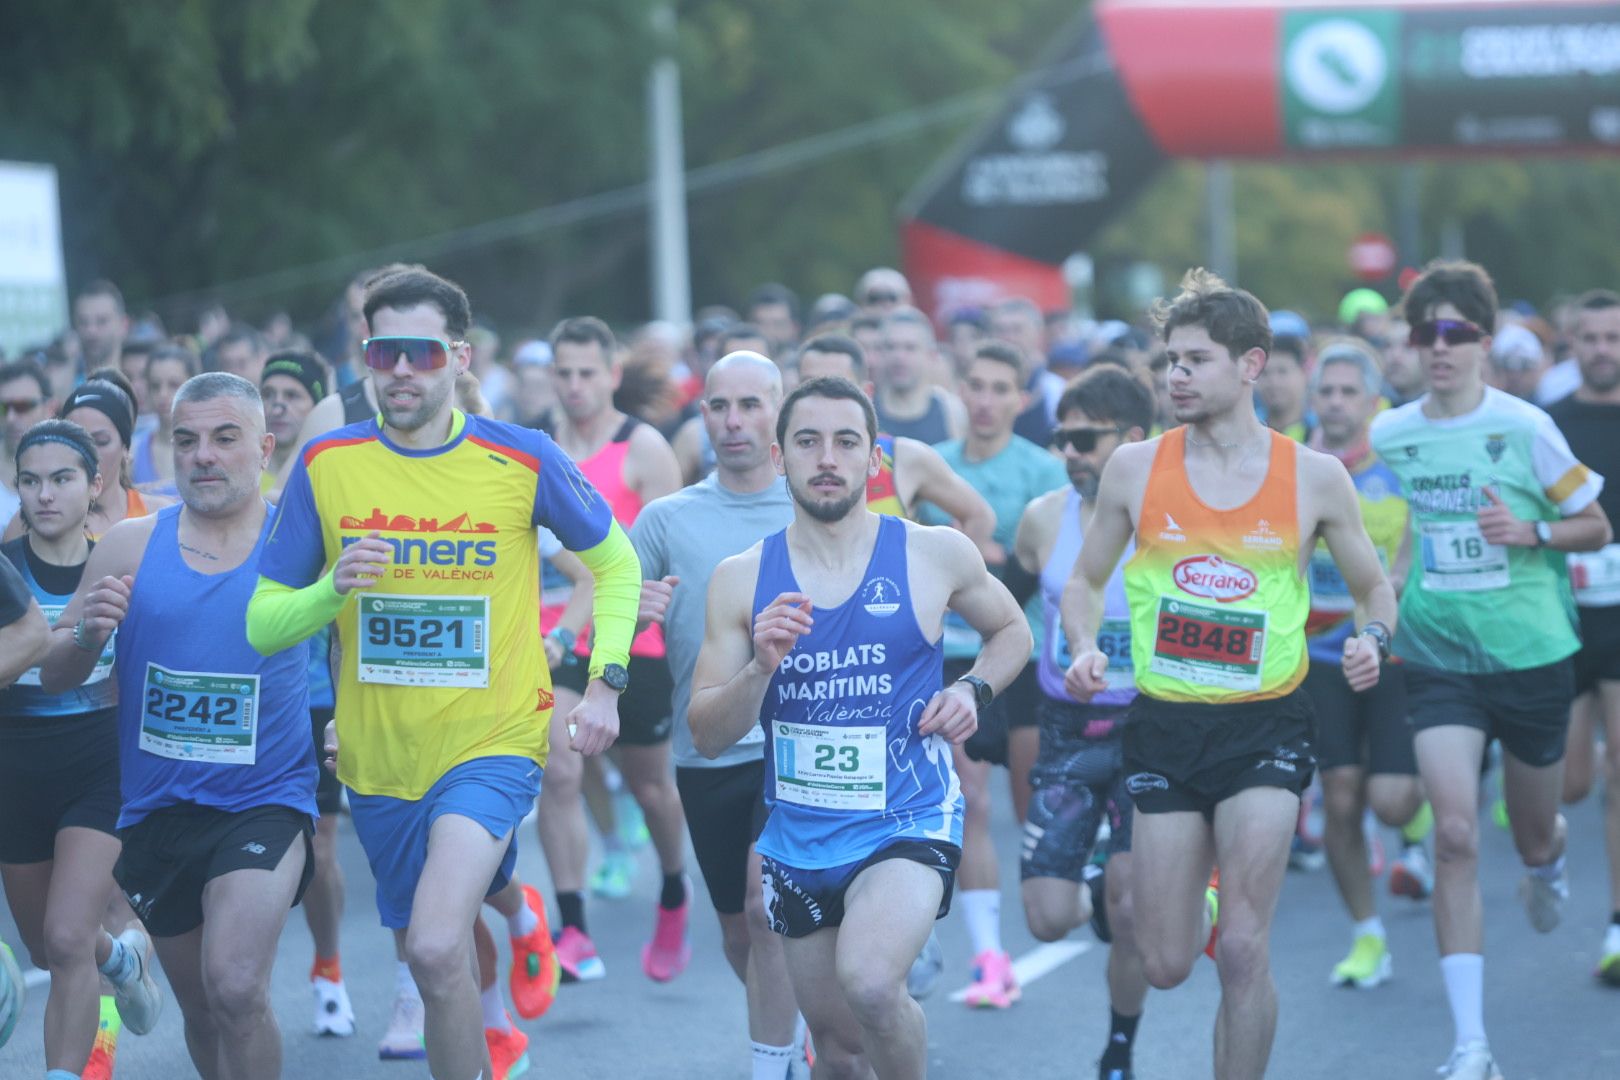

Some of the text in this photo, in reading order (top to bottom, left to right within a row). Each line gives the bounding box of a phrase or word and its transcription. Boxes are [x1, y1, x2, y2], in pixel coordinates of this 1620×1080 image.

[1450, 537, 1482, 559] 16
[394, 569, 415, 579] DE
[422, 567, 494, 580] VALÈNCIA
[1181, 565, 1251, 590] Serrano
[368, 616, 463, 648] 9521
[1160, 616, 1248, 656] 2848
[780, 643, 886, 674] POBLATS
[778, 673, 892, 704] MARÍTIMS
[147, 687, 237, 726] 2242
[815, 744, 859, 772] 23
